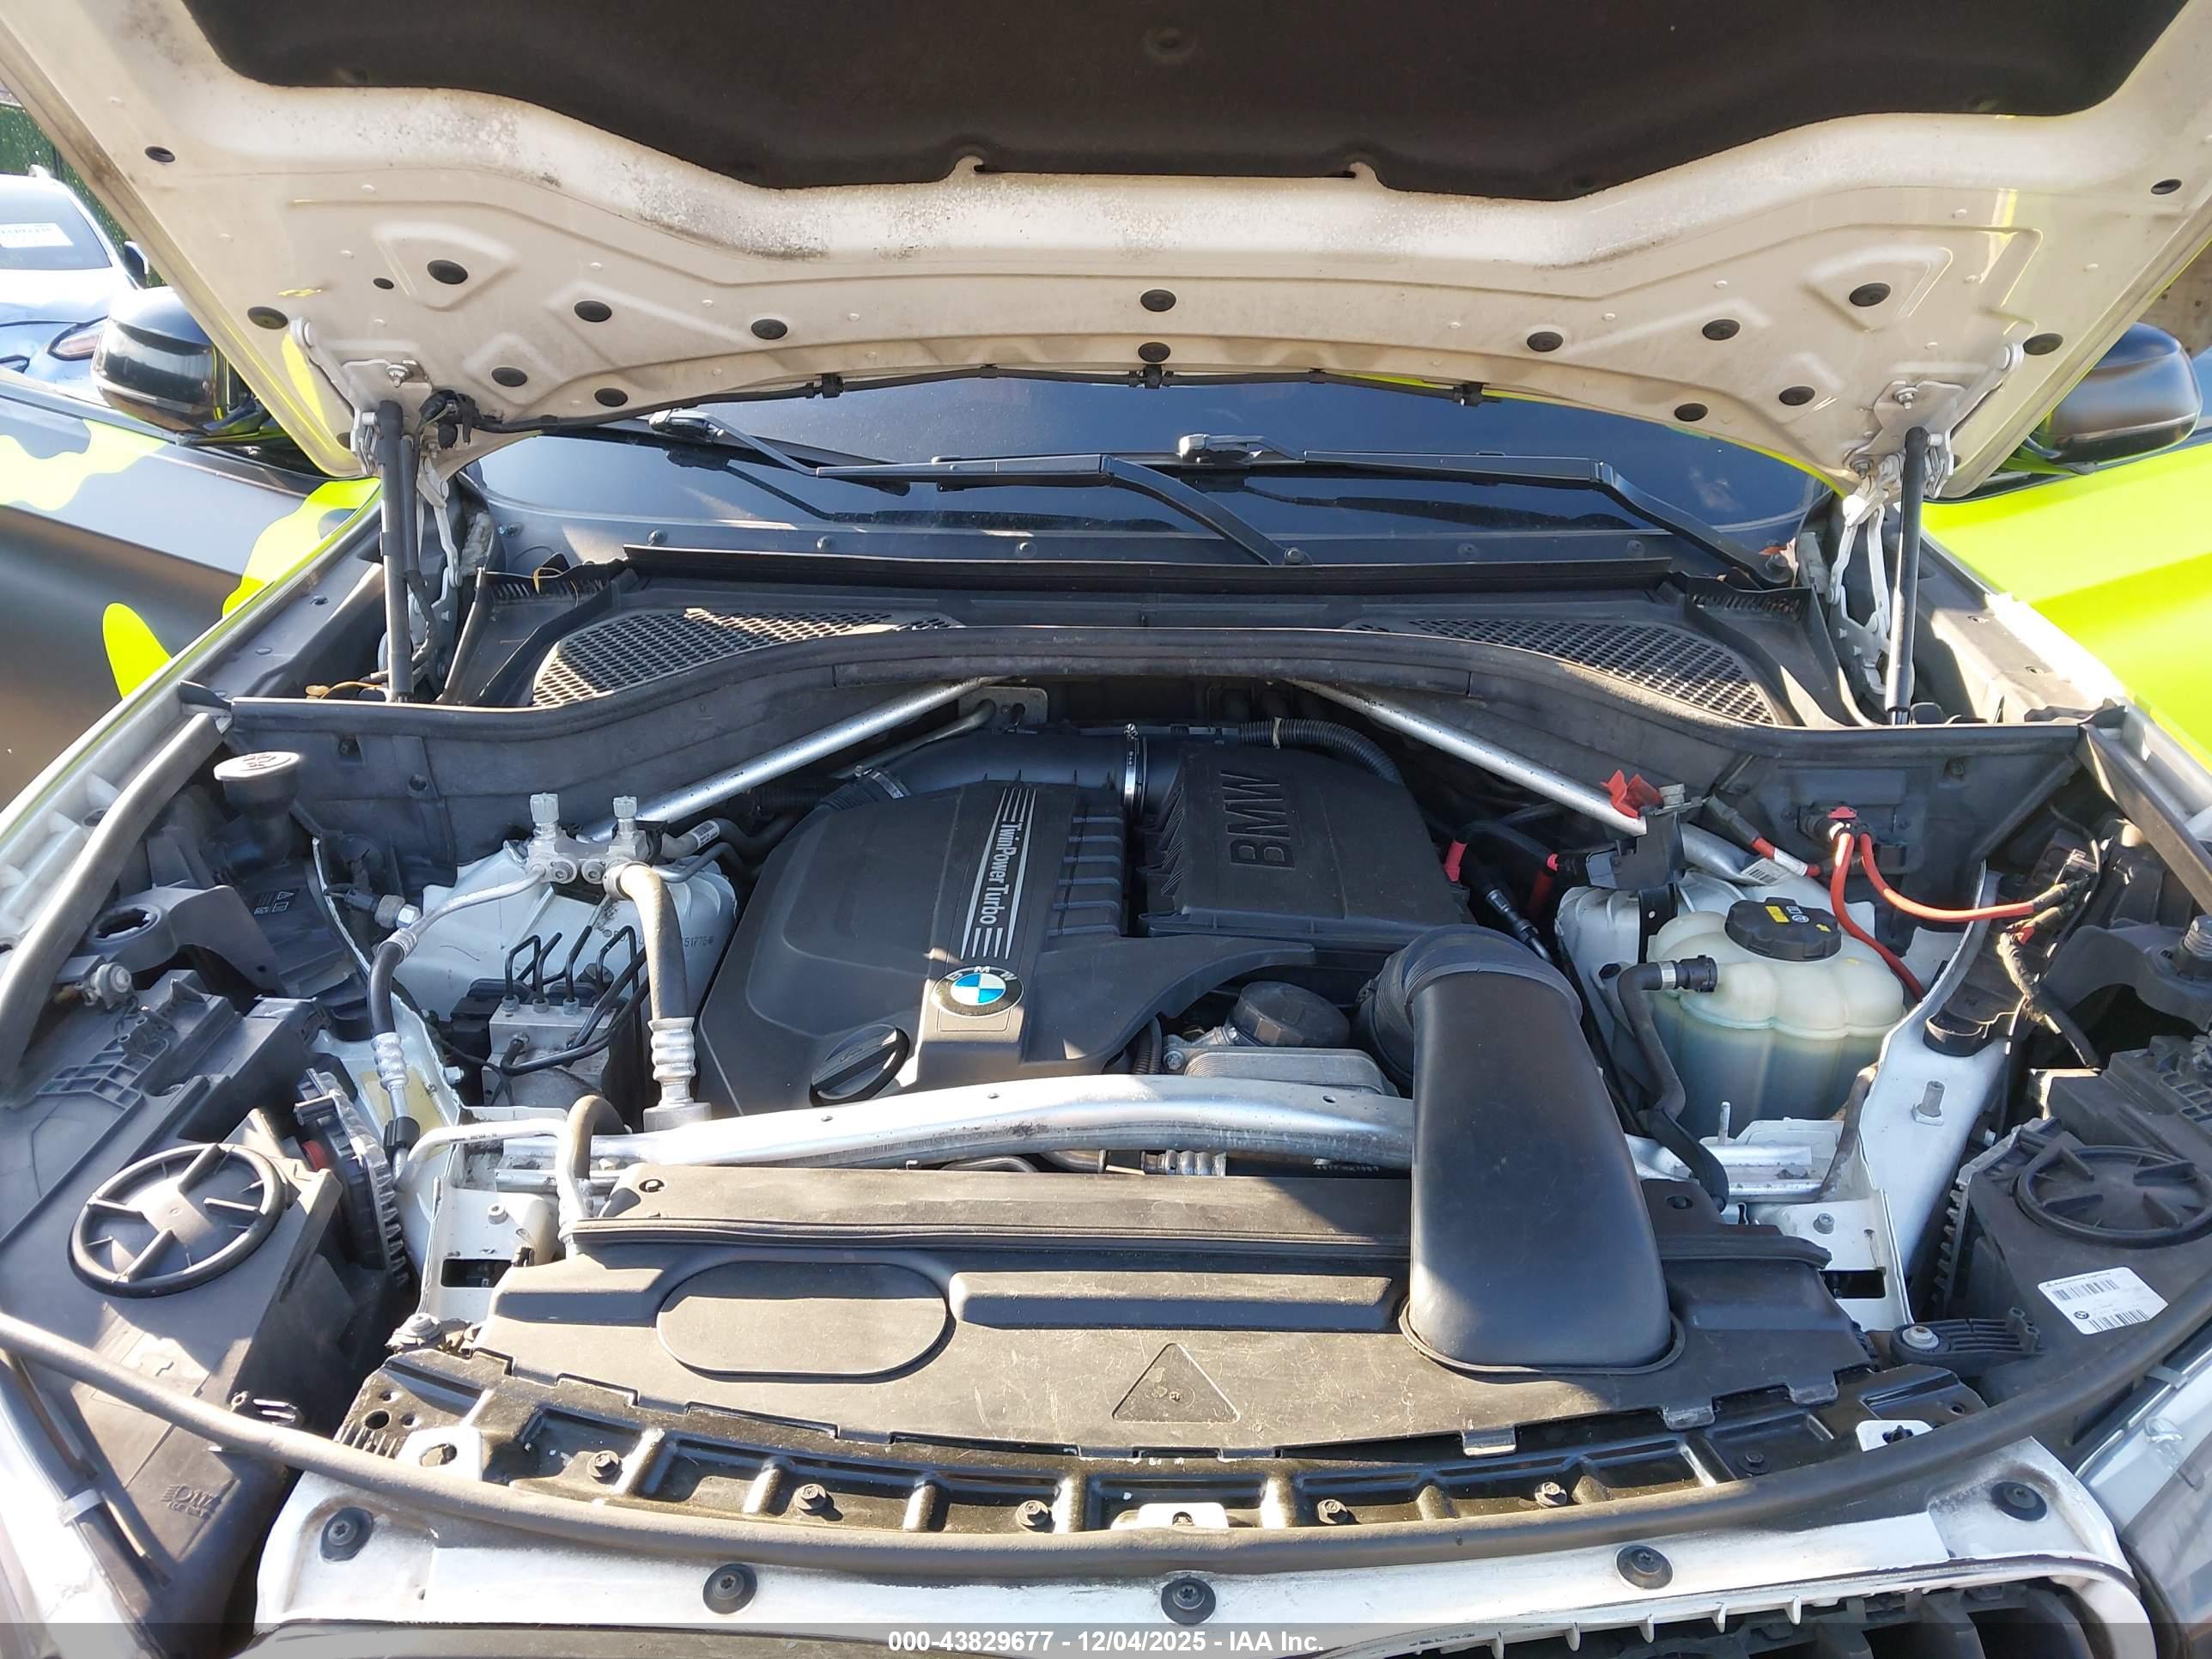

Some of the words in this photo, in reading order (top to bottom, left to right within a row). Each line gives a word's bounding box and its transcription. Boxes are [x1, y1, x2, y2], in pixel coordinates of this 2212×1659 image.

[1220, 769, 1296, 870] BMW
[988, 822, 1023, 884] TwinPower
[979, 884, 1010, 925] Turbo
[945, 965, 1018, 981] BMW
